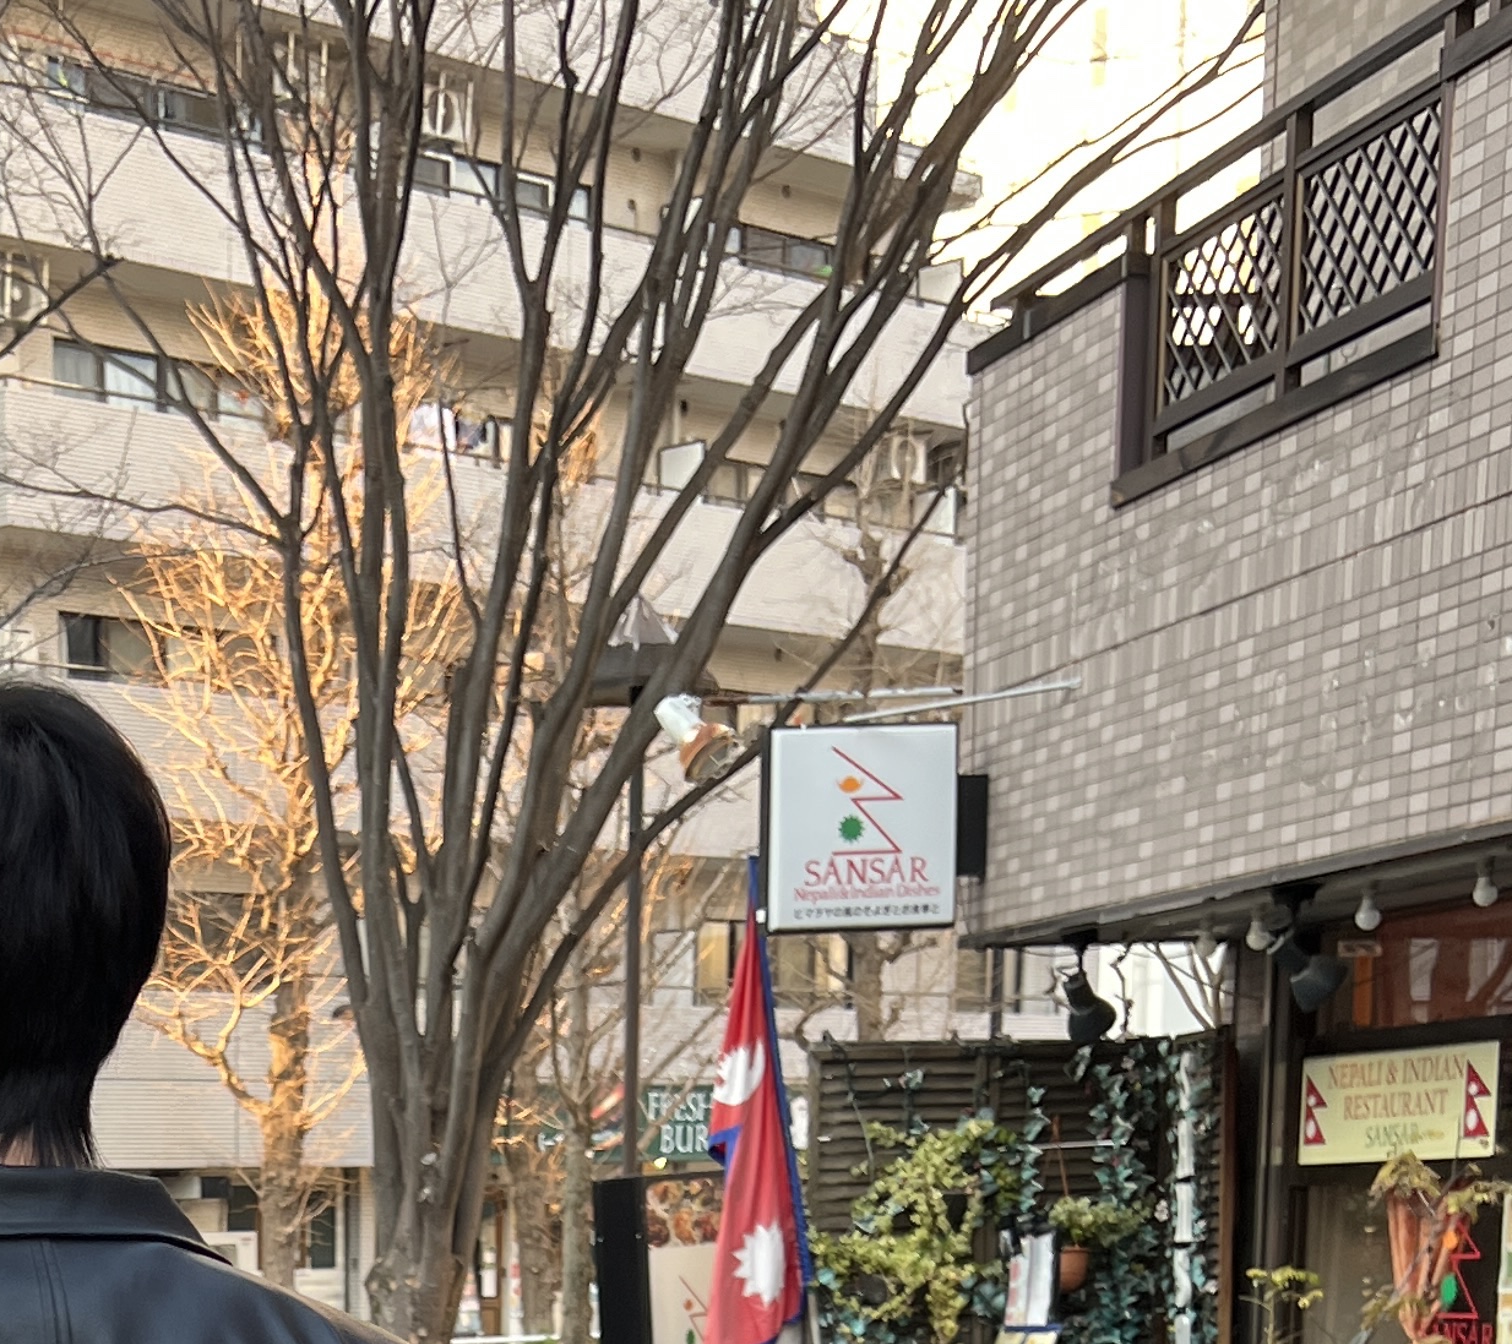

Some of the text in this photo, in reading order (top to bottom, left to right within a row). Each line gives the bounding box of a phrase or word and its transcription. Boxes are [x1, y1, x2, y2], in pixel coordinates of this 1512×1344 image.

[804, 854, 929, 887] SANSAR
[1328, 1053, 1466, 1089] NEPALI & INDIAN
[1343, 1088, 1449, 1121] RESTAURANT
